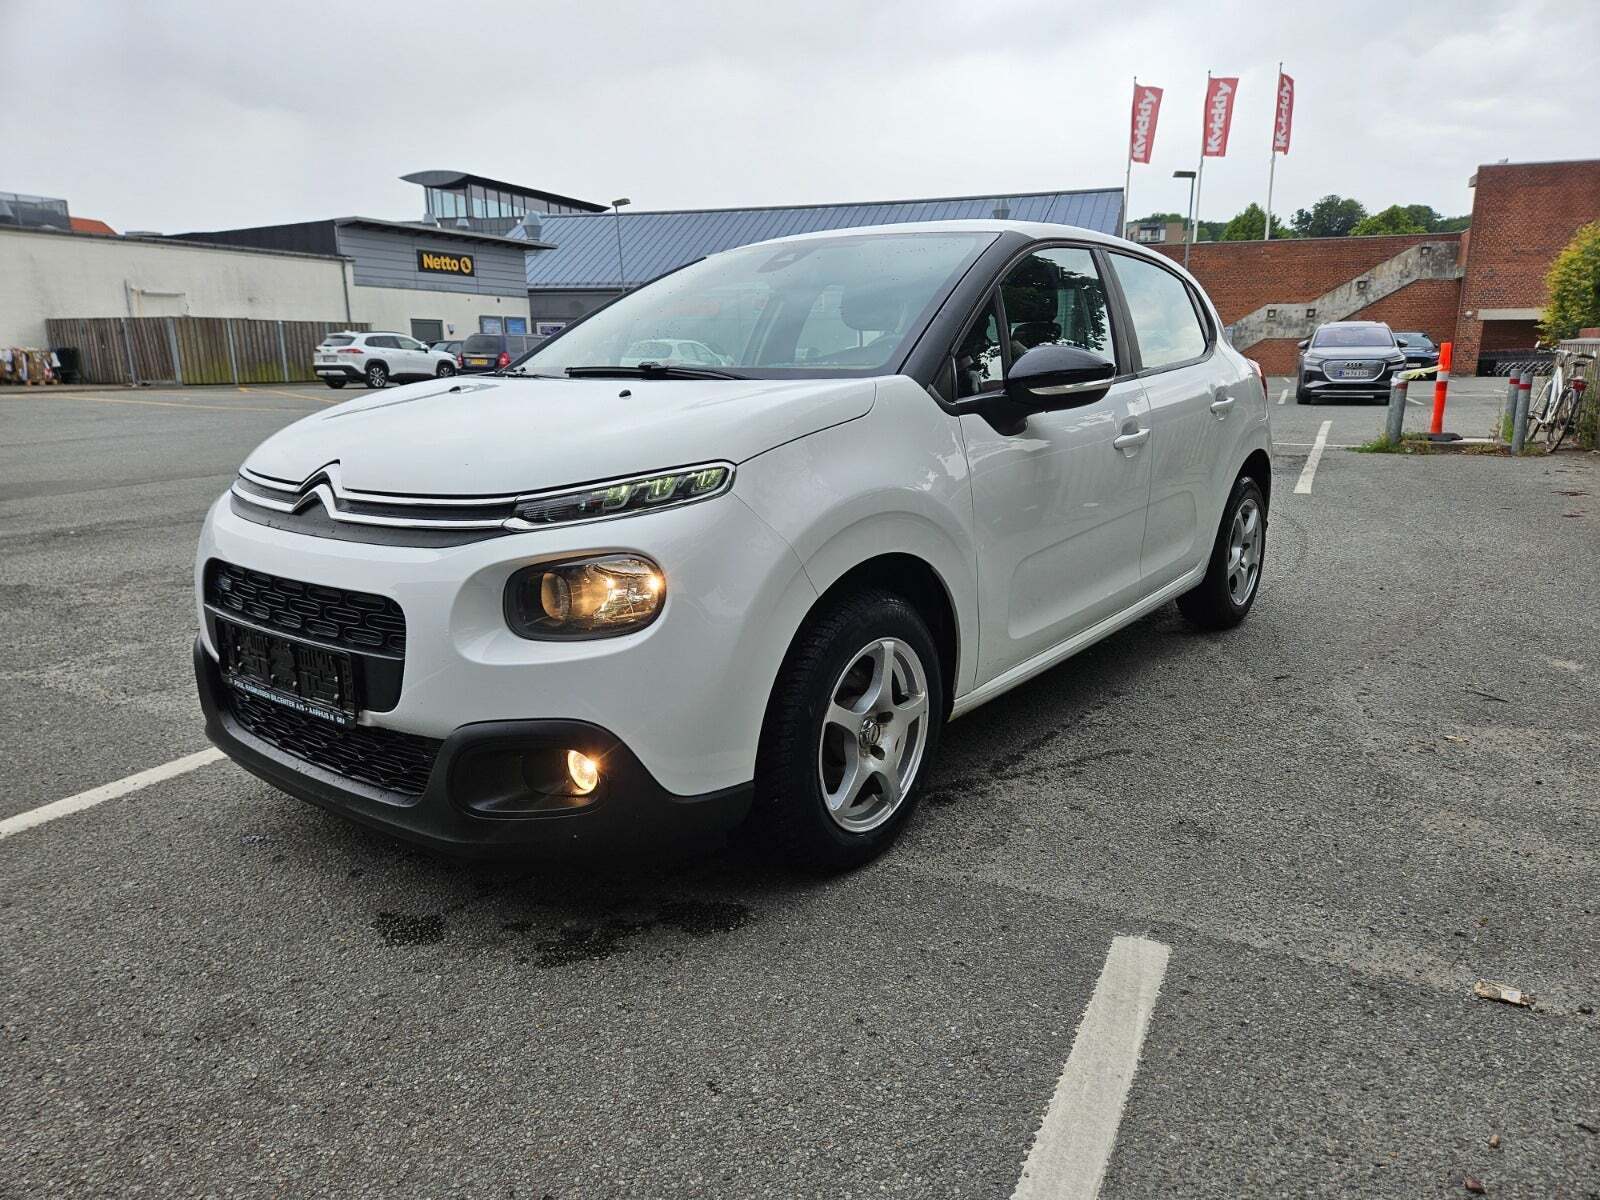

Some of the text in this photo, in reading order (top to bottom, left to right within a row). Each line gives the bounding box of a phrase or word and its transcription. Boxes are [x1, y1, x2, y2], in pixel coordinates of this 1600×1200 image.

[1132, 89, 1157, 159] Kvickly
[1207, 81, 1232, 152] Kvickly
[423, 253, 459, 271] Netto
